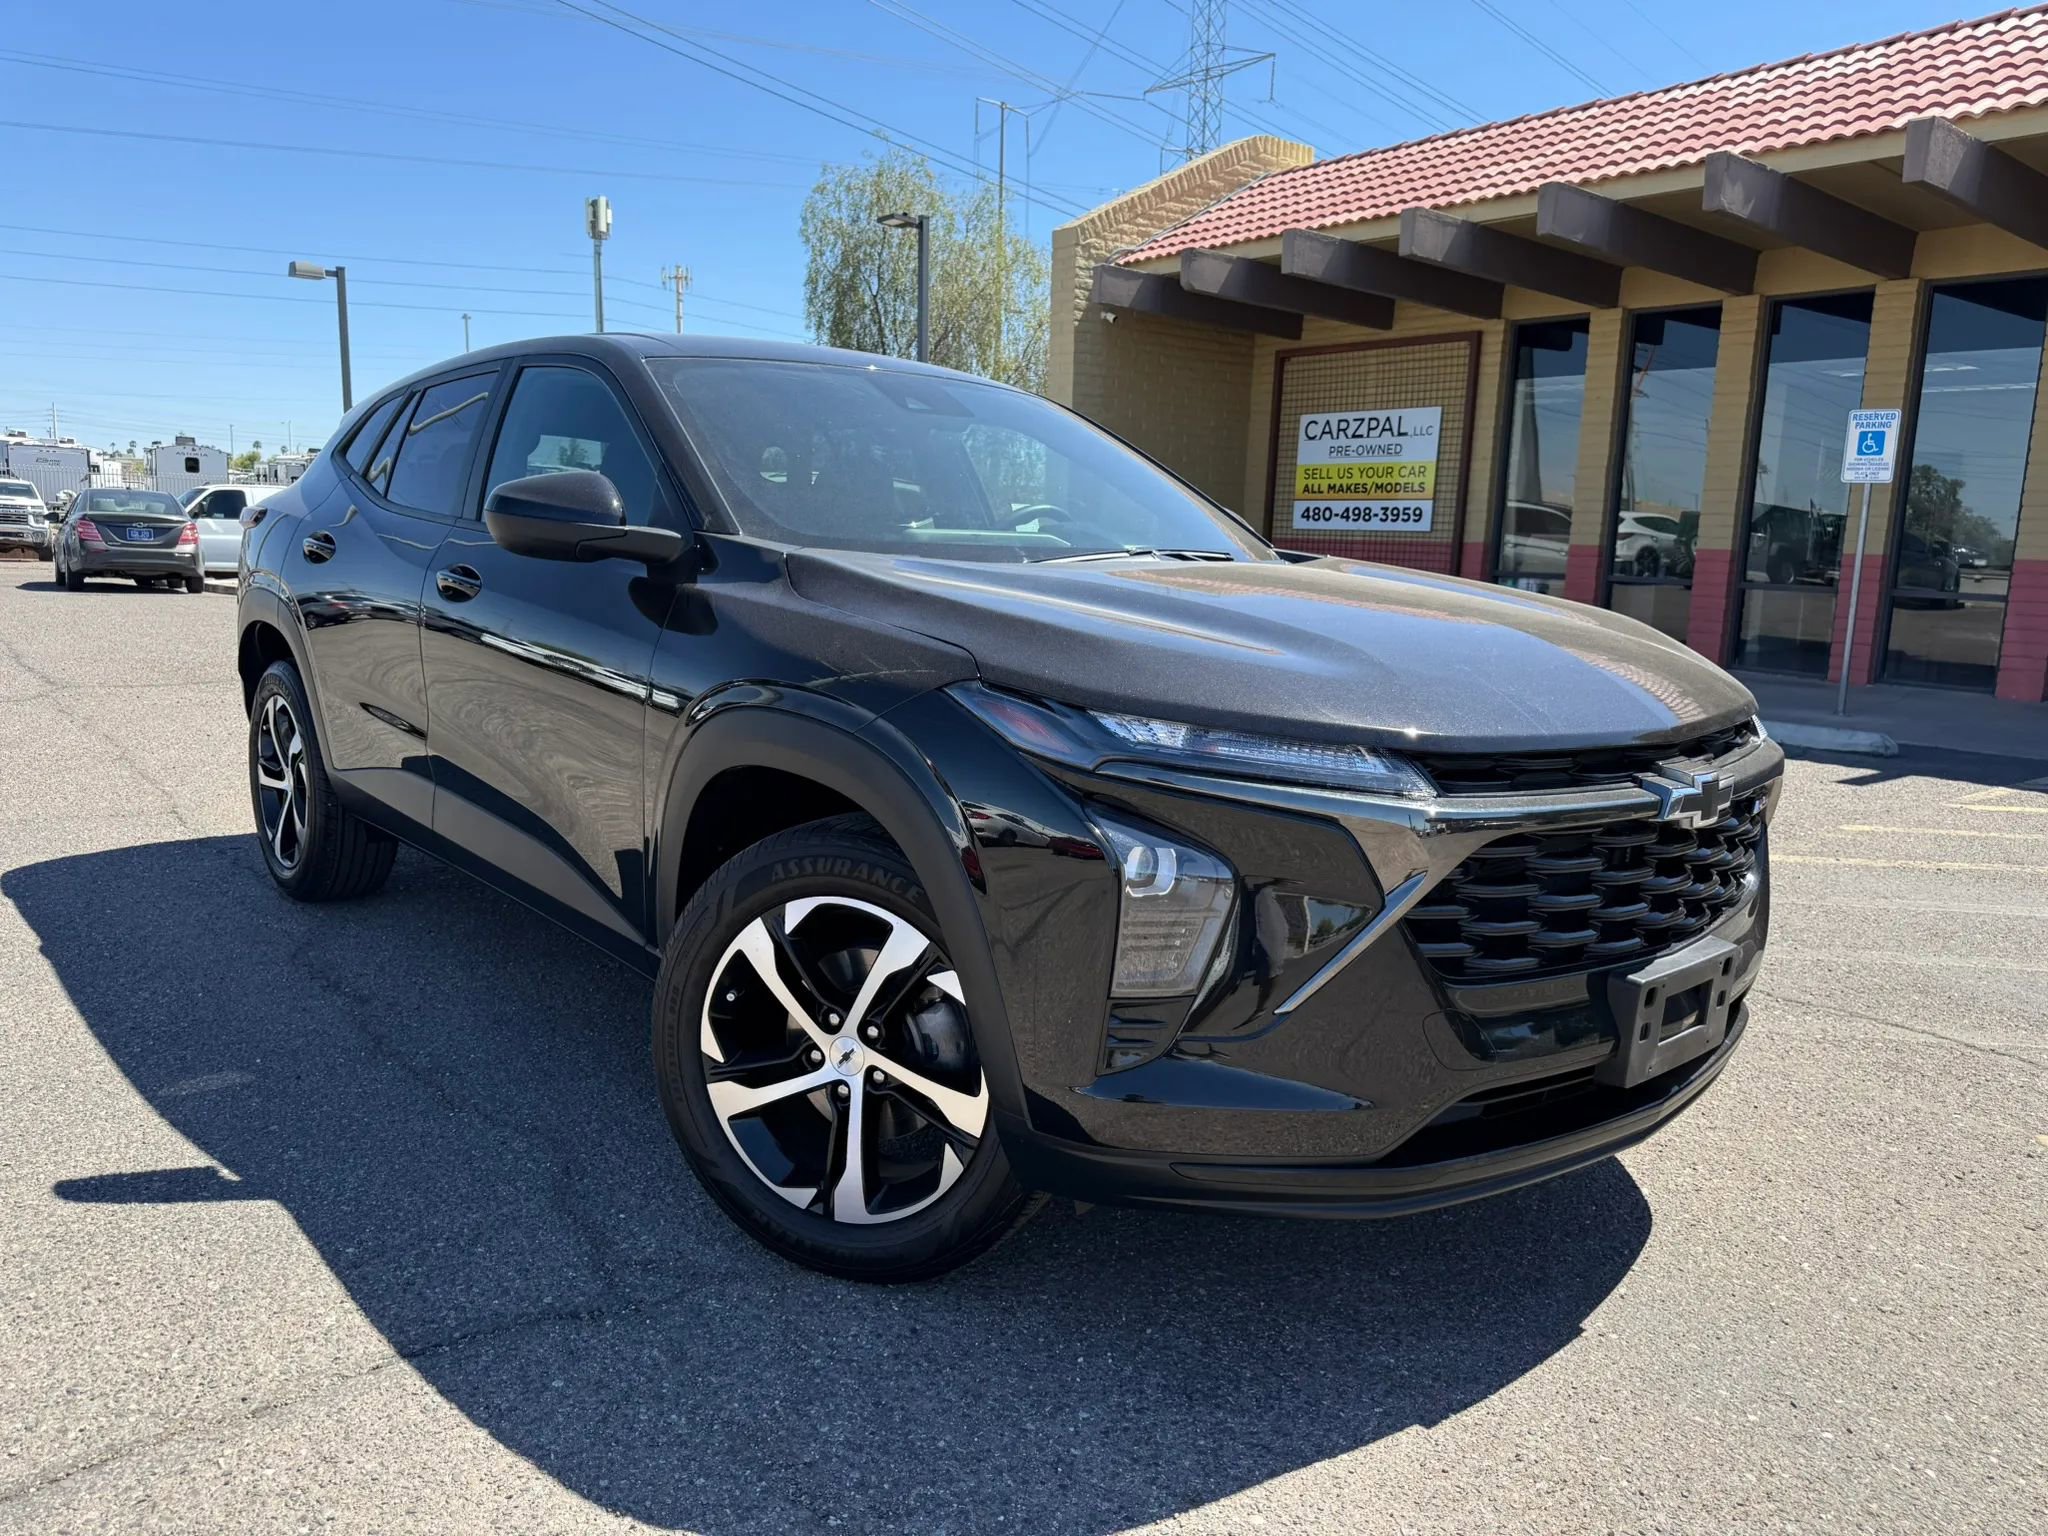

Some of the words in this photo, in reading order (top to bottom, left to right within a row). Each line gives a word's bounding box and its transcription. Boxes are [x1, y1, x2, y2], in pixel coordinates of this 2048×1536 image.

[1853, 412, 1896, 421] RESERVED
[1304, 416, 1408, 440] CARZPAL
[1855, 421, 1892, 429] PARKING
[1328, 443, 1403, 457] PRE-OWNED
[1303, 468, 1333, 480] SELL
[1337, 467, 1353, 479] US
[1358, 466, 1394, 478] YOUR
[1398, 465, 1427, 478] CAR
[1302, 484, 1324, 494] ALL
[1327, 482, 1425, 495] MAKES/MODELS
[1301, 506, 1423, 523] 480-498-3959
[772, 857, 925, 901] ASSURANCE
